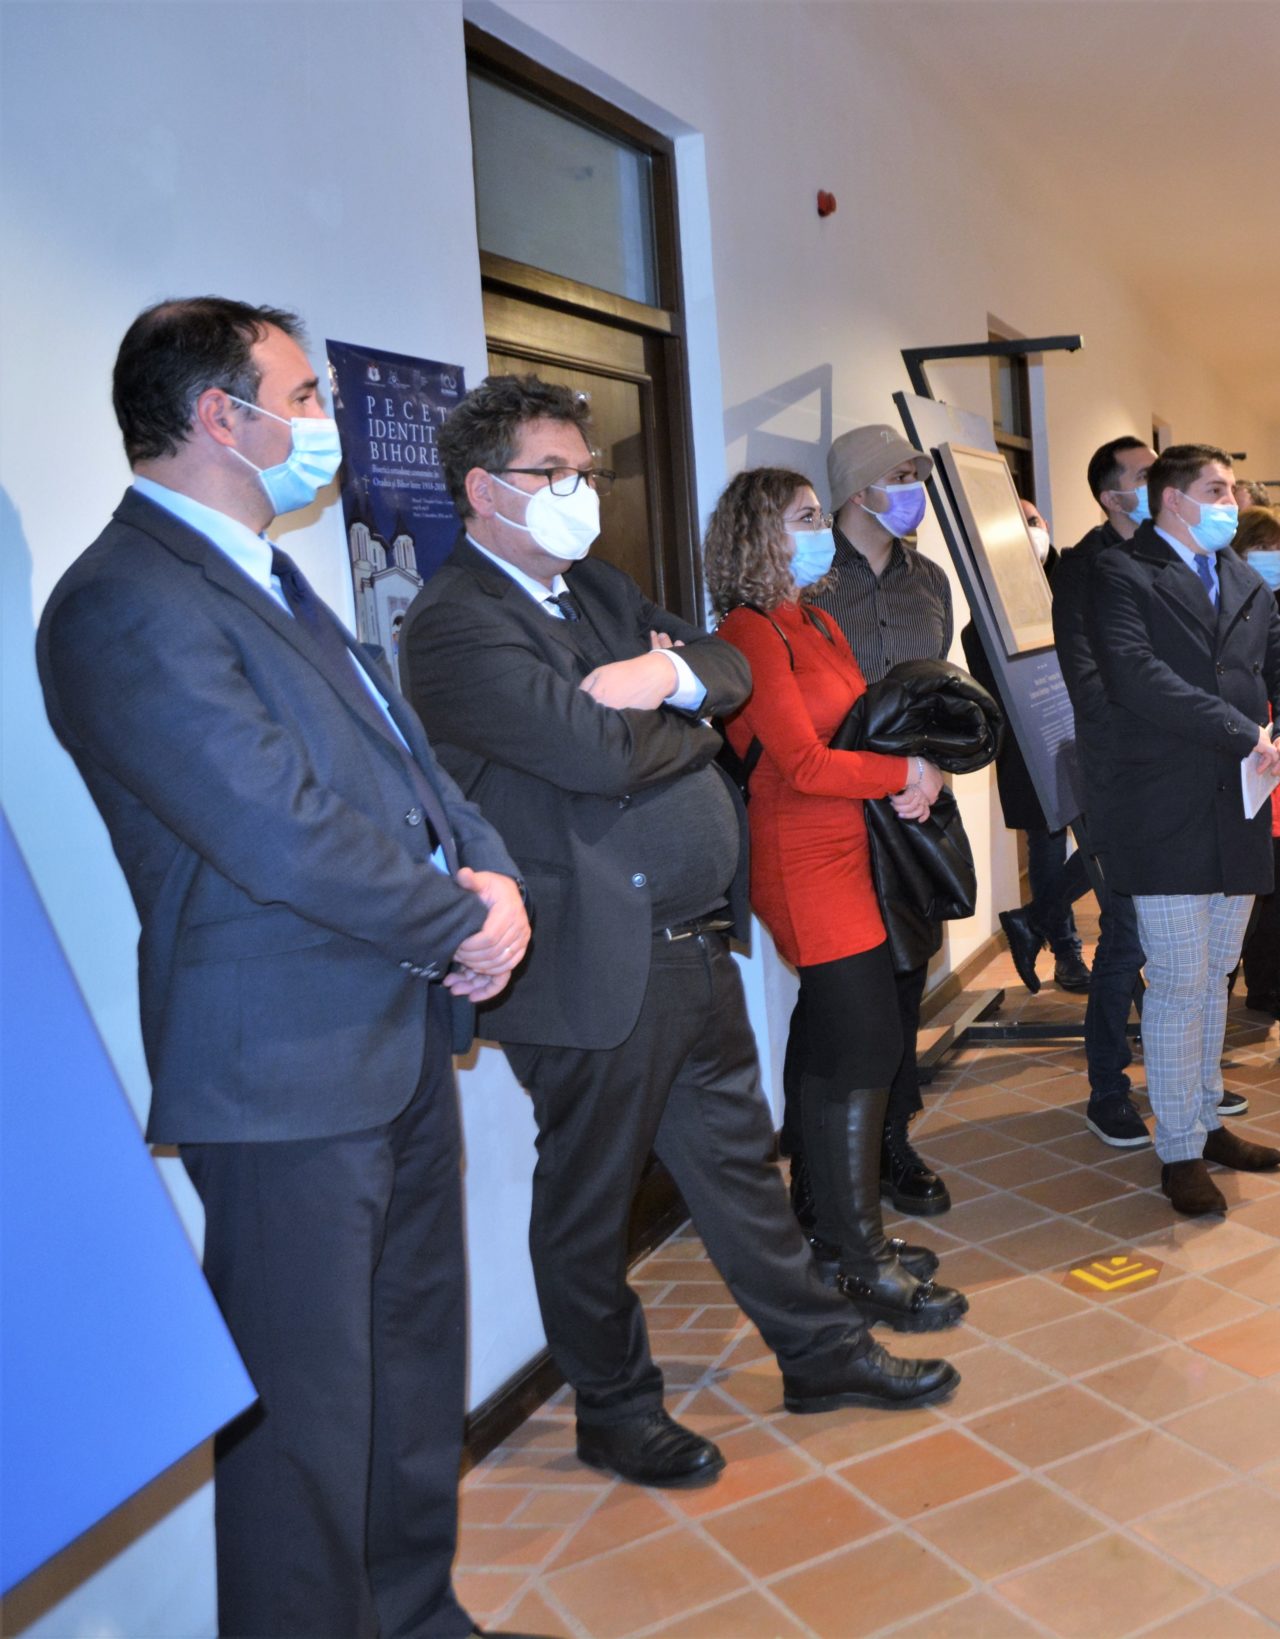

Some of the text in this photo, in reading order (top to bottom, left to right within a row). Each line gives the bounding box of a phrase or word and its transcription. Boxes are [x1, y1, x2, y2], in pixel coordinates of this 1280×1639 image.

[367, 395, 447, 423] PECET
[368, 418, 439, 445] IDENTIT
[369, 441, 447, 467] BIHORE
